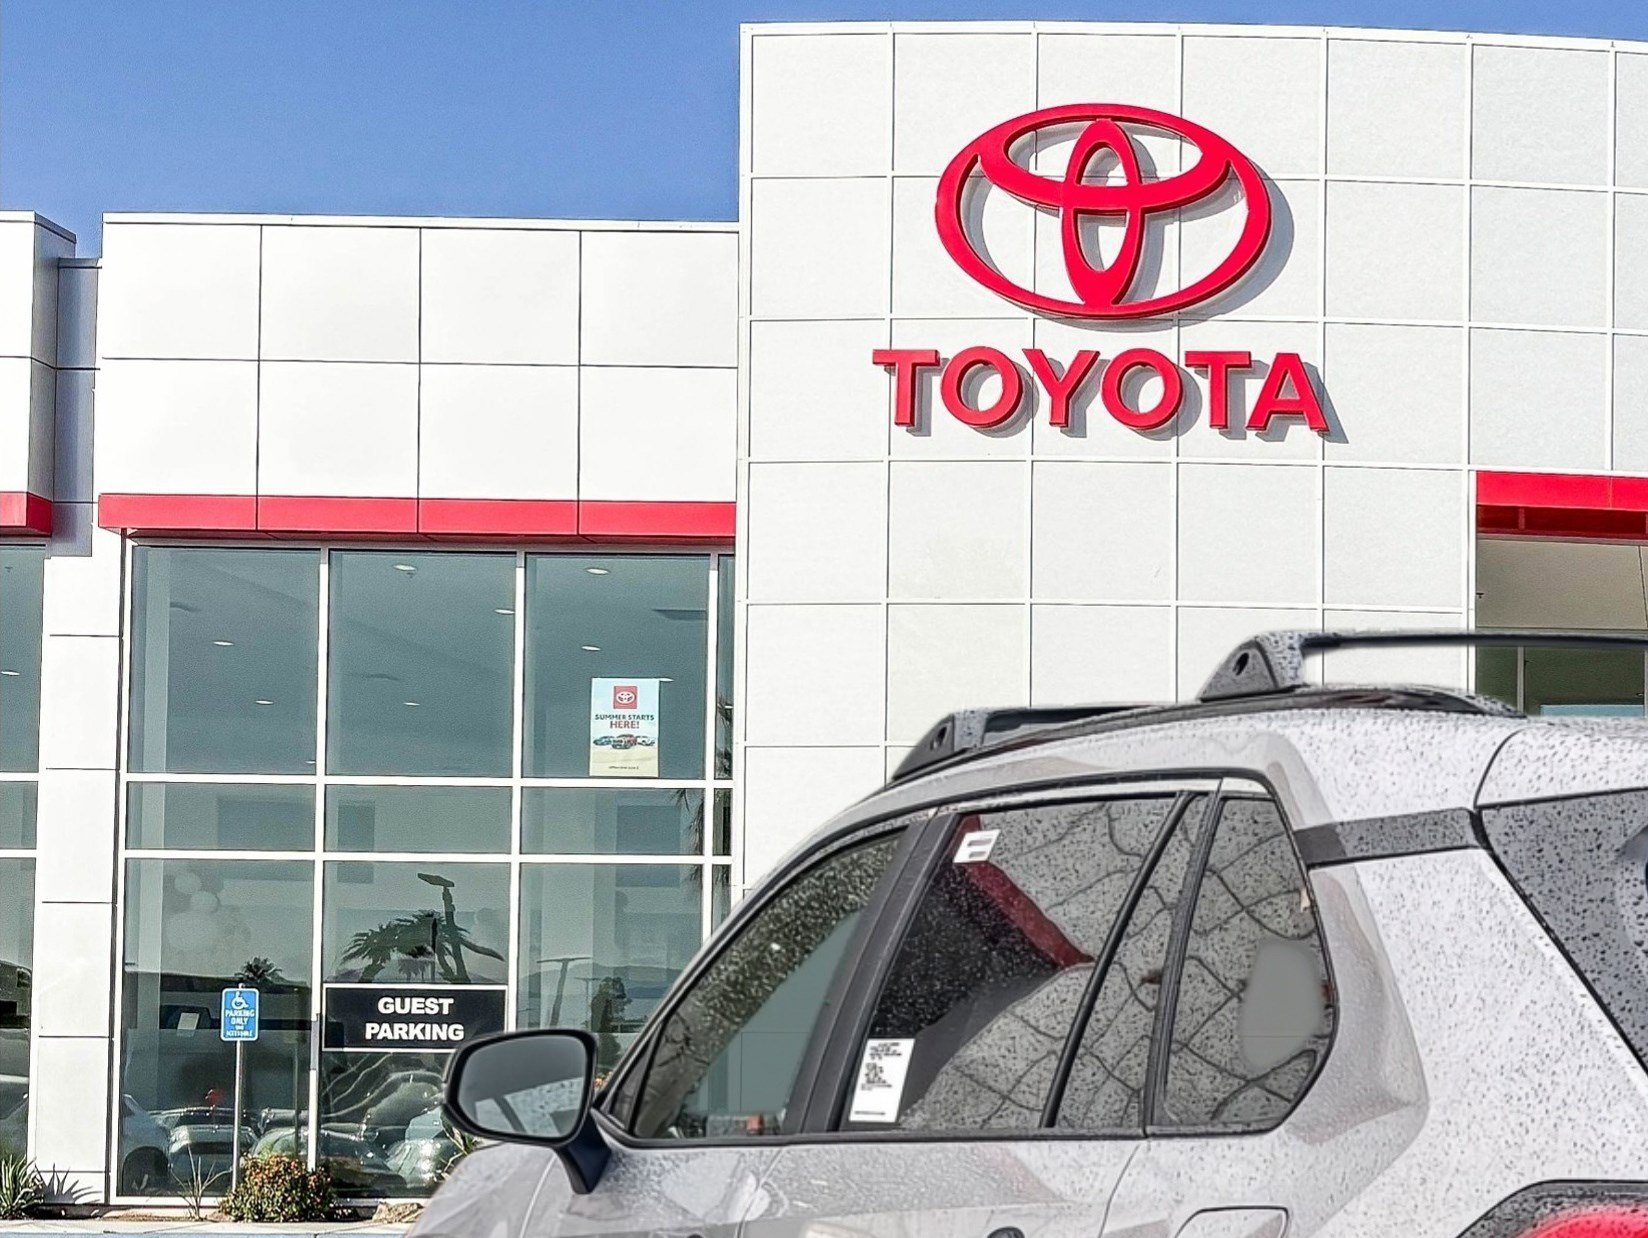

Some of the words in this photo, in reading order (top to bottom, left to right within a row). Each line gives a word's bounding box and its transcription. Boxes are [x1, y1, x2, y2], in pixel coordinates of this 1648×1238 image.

[872, 346, 1329, 435] TOYOTA
[609, 720, 640, 729] HERE!
[377, 997, 454, 1015] GUEST
[365, 1022, 465, 1041] PARKING
